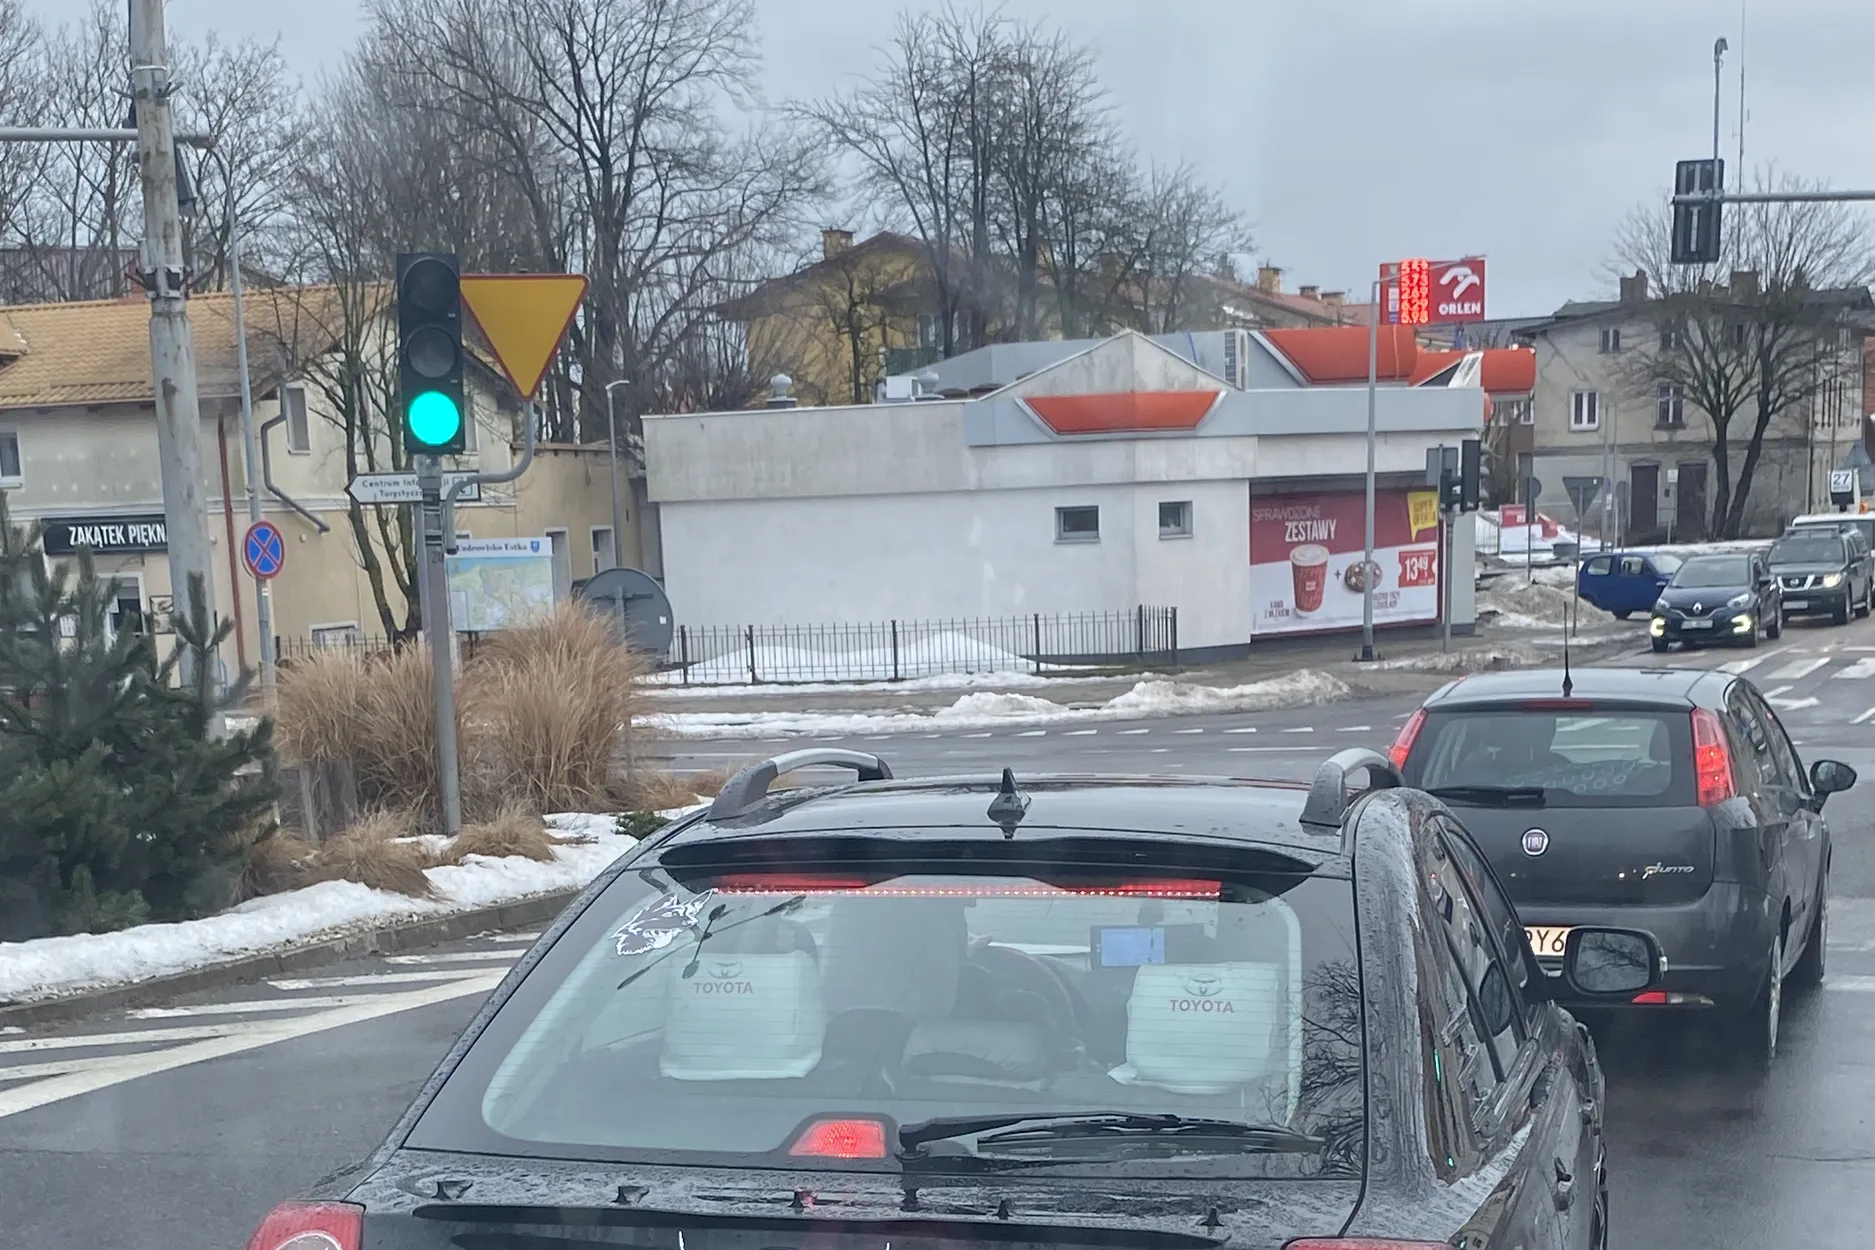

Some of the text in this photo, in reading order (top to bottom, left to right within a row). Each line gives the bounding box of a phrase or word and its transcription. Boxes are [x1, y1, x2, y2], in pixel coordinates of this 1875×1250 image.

[1439, 302, 1482, 315] ORLEN
[362, 480, 400, 488] Centrum
[1833, 473, 1850, 485] 27
[1252, 505, 1321, 522] SPRAWDZONE
[68, 523, 166, 548] ZAKĄTEK PIĘKN
[1285, 519, 1337, 542] ZESTAWY
[1528, 837, 1542, 849] FIAT
[693, 982, 754, 994] TOYOTA
[1169, 999, 1234, 1013] TOYOTA
